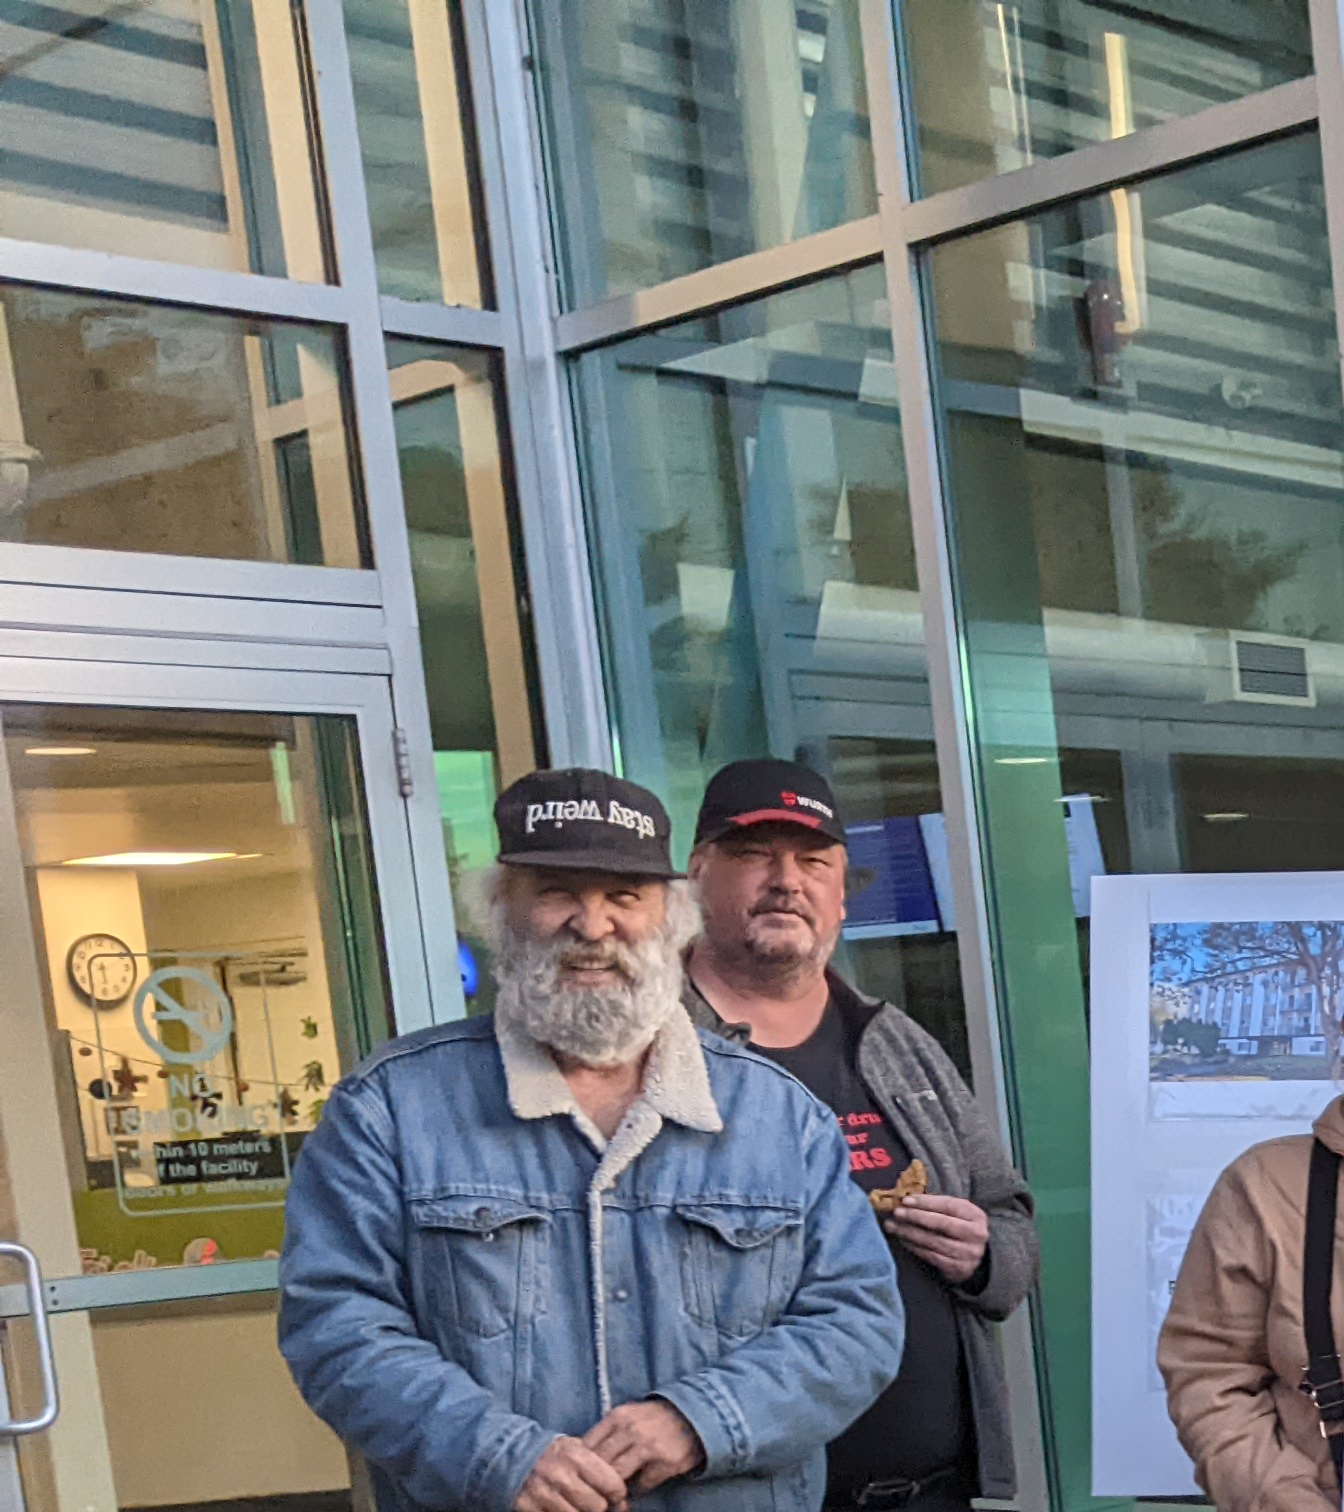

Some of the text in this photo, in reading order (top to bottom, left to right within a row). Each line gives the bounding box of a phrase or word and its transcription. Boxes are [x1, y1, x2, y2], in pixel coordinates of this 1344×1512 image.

[526, 799, 656, 839] stay weird
[169, 1073, 212, 1098] NO
[189, 1142, 209, 1157] 10
[213, 1140, 272, 1156] meters
[169, 1164, 197, 1178] the
[201, 1159, 259, 1177] facility
